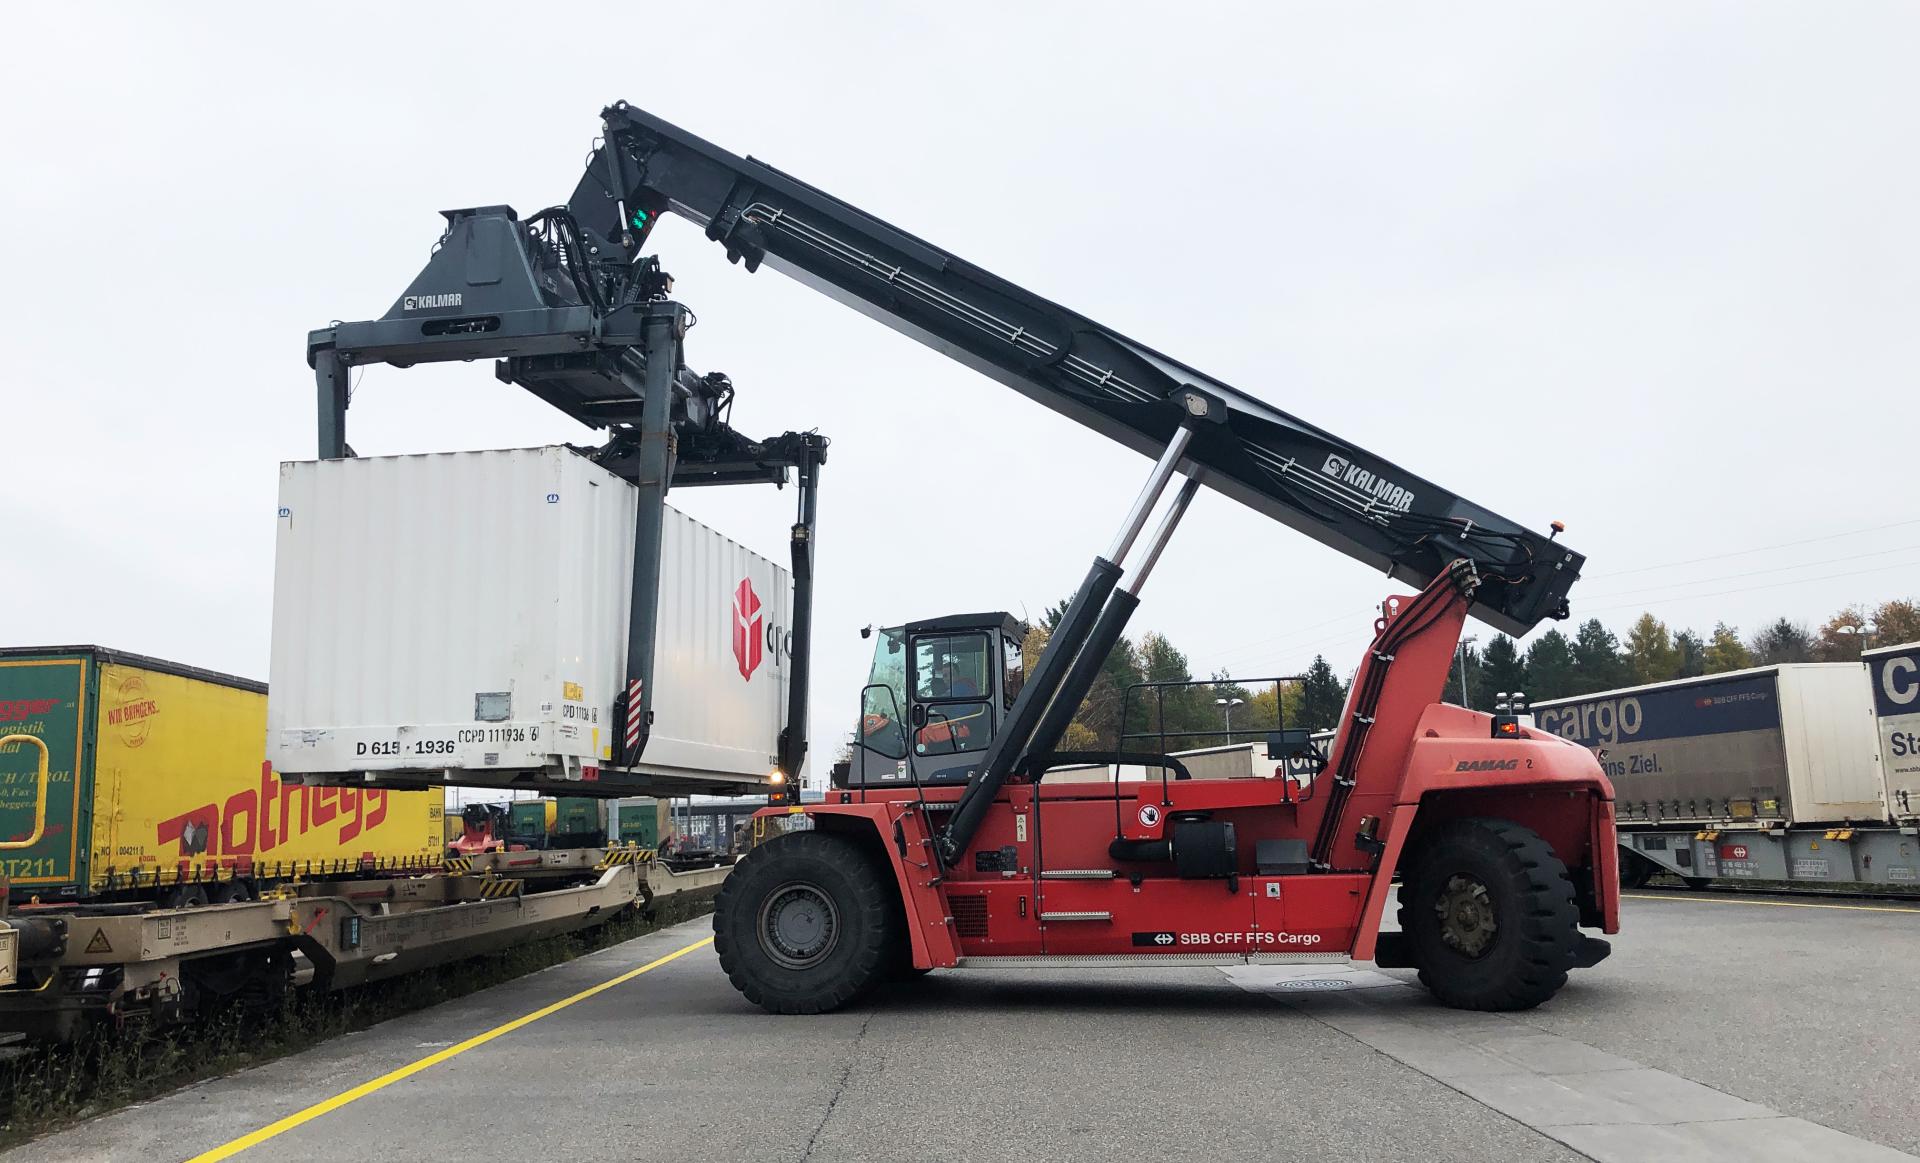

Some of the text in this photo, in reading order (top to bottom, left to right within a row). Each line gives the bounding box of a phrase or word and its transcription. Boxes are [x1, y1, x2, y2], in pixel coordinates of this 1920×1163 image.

[419, 294, 462, 309] KALMAR
[1344, 465, 1415, 511] KALMAR
[109, 707, 123, 725] WIR
[1541, 697, 1642, 744] cargo
[459, 728, 537, 744] CCPD 111936 6
[357, 739, 455, 755] D 615 1936
[1455, 758, 1533, 772] BAMAG 2
[1630, 753, 1662, 774] Ziel.
[29, 769, 71, 784] TROL
[1180, 931, 1321, 946] SBB CFF FFS Cargo
